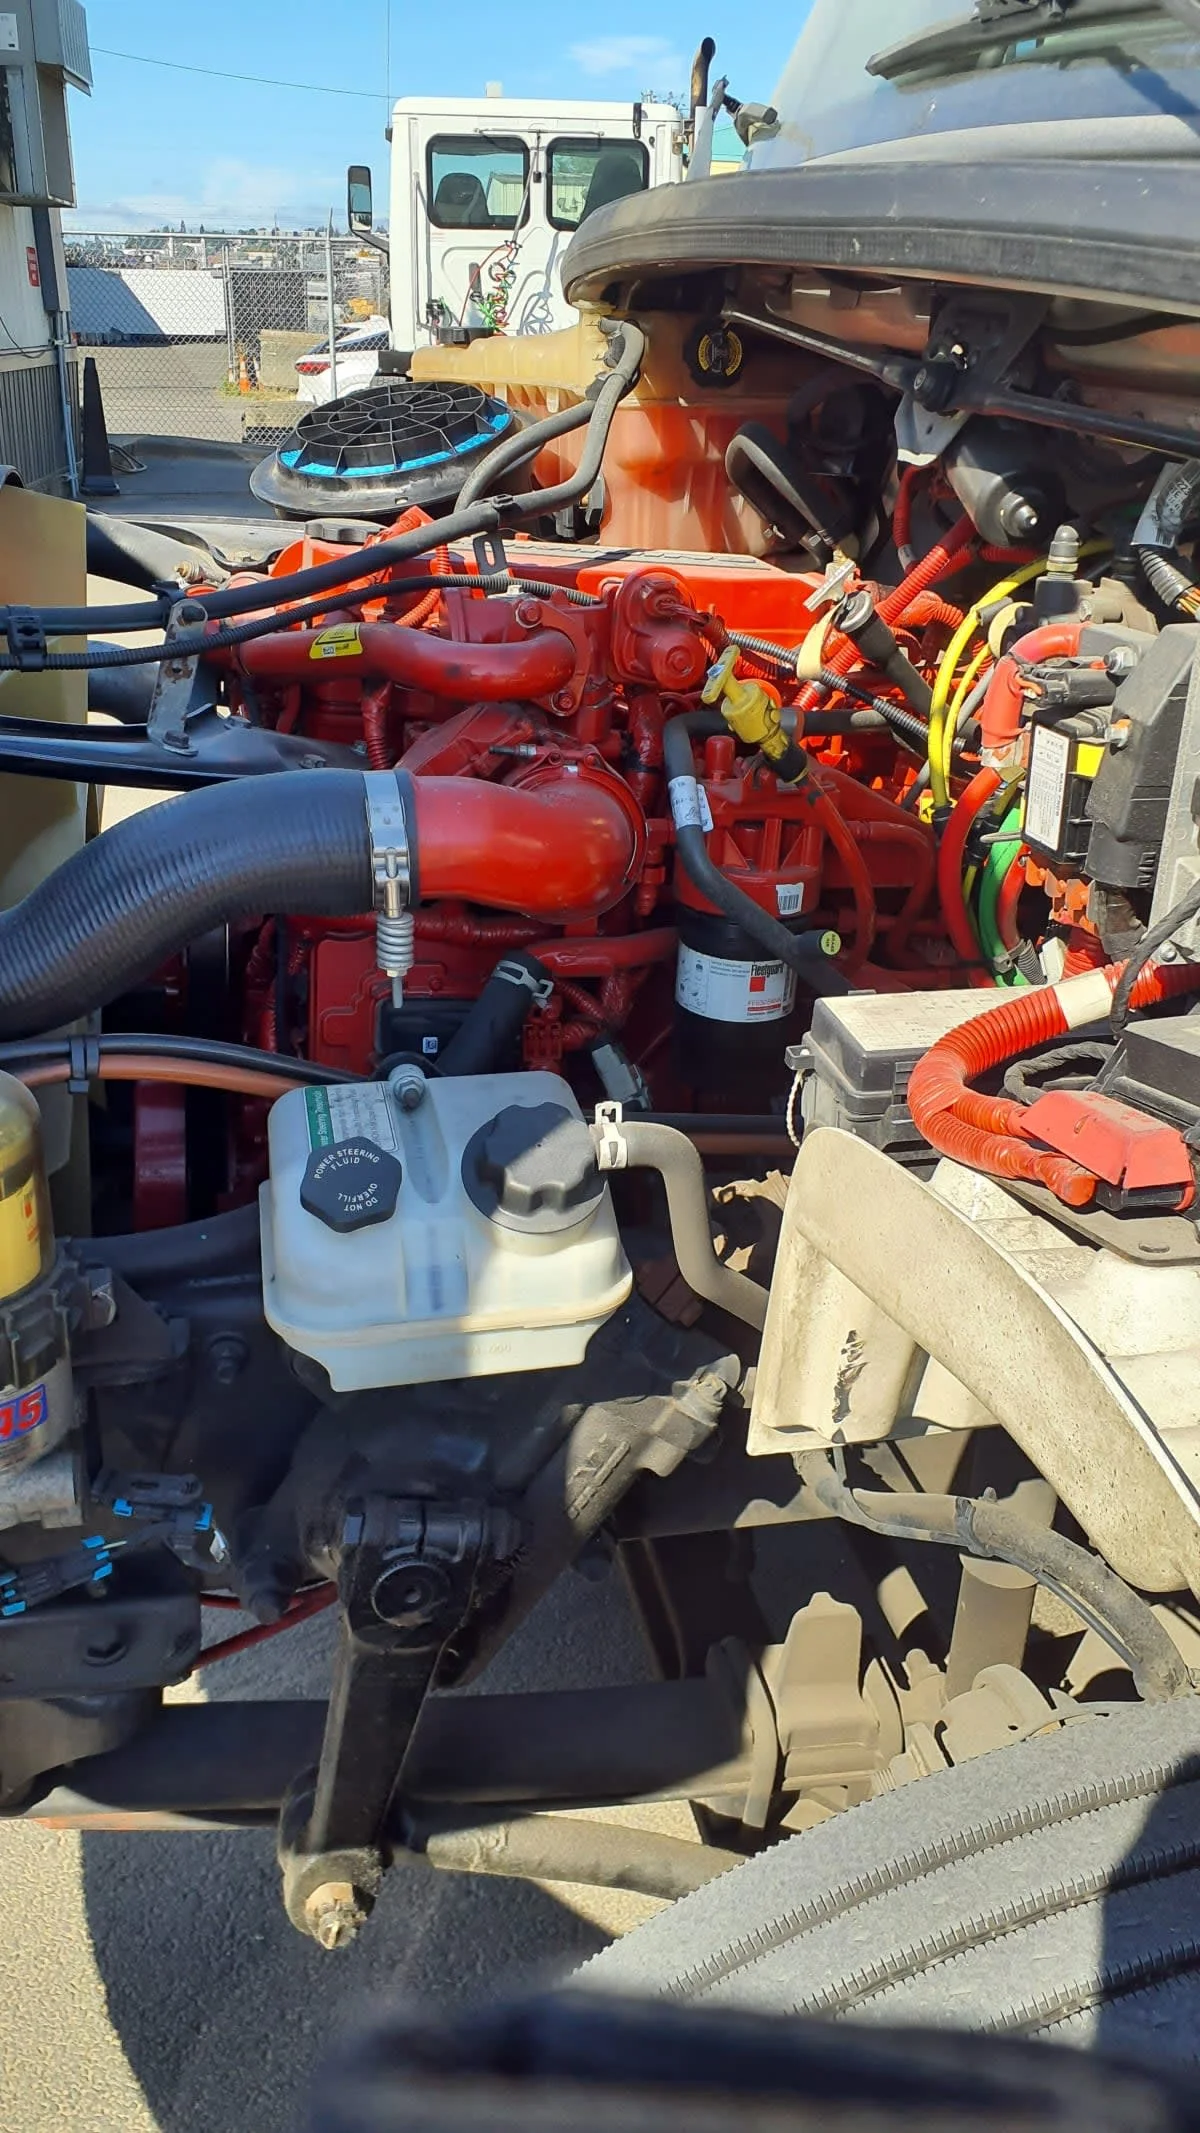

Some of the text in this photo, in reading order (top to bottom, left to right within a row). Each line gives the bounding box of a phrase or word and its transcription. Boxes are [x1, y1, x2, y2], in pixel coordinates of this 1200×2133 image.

[319, 1112, 328, 1135] Steering
[314, 1148, 380, 1179] POWER STEERING
[331, 1157, 360, 1171] FLUID
[337, 1183, 378, 1202] OVERFILL
[344, 1196, 378, 1212] DO NOT
